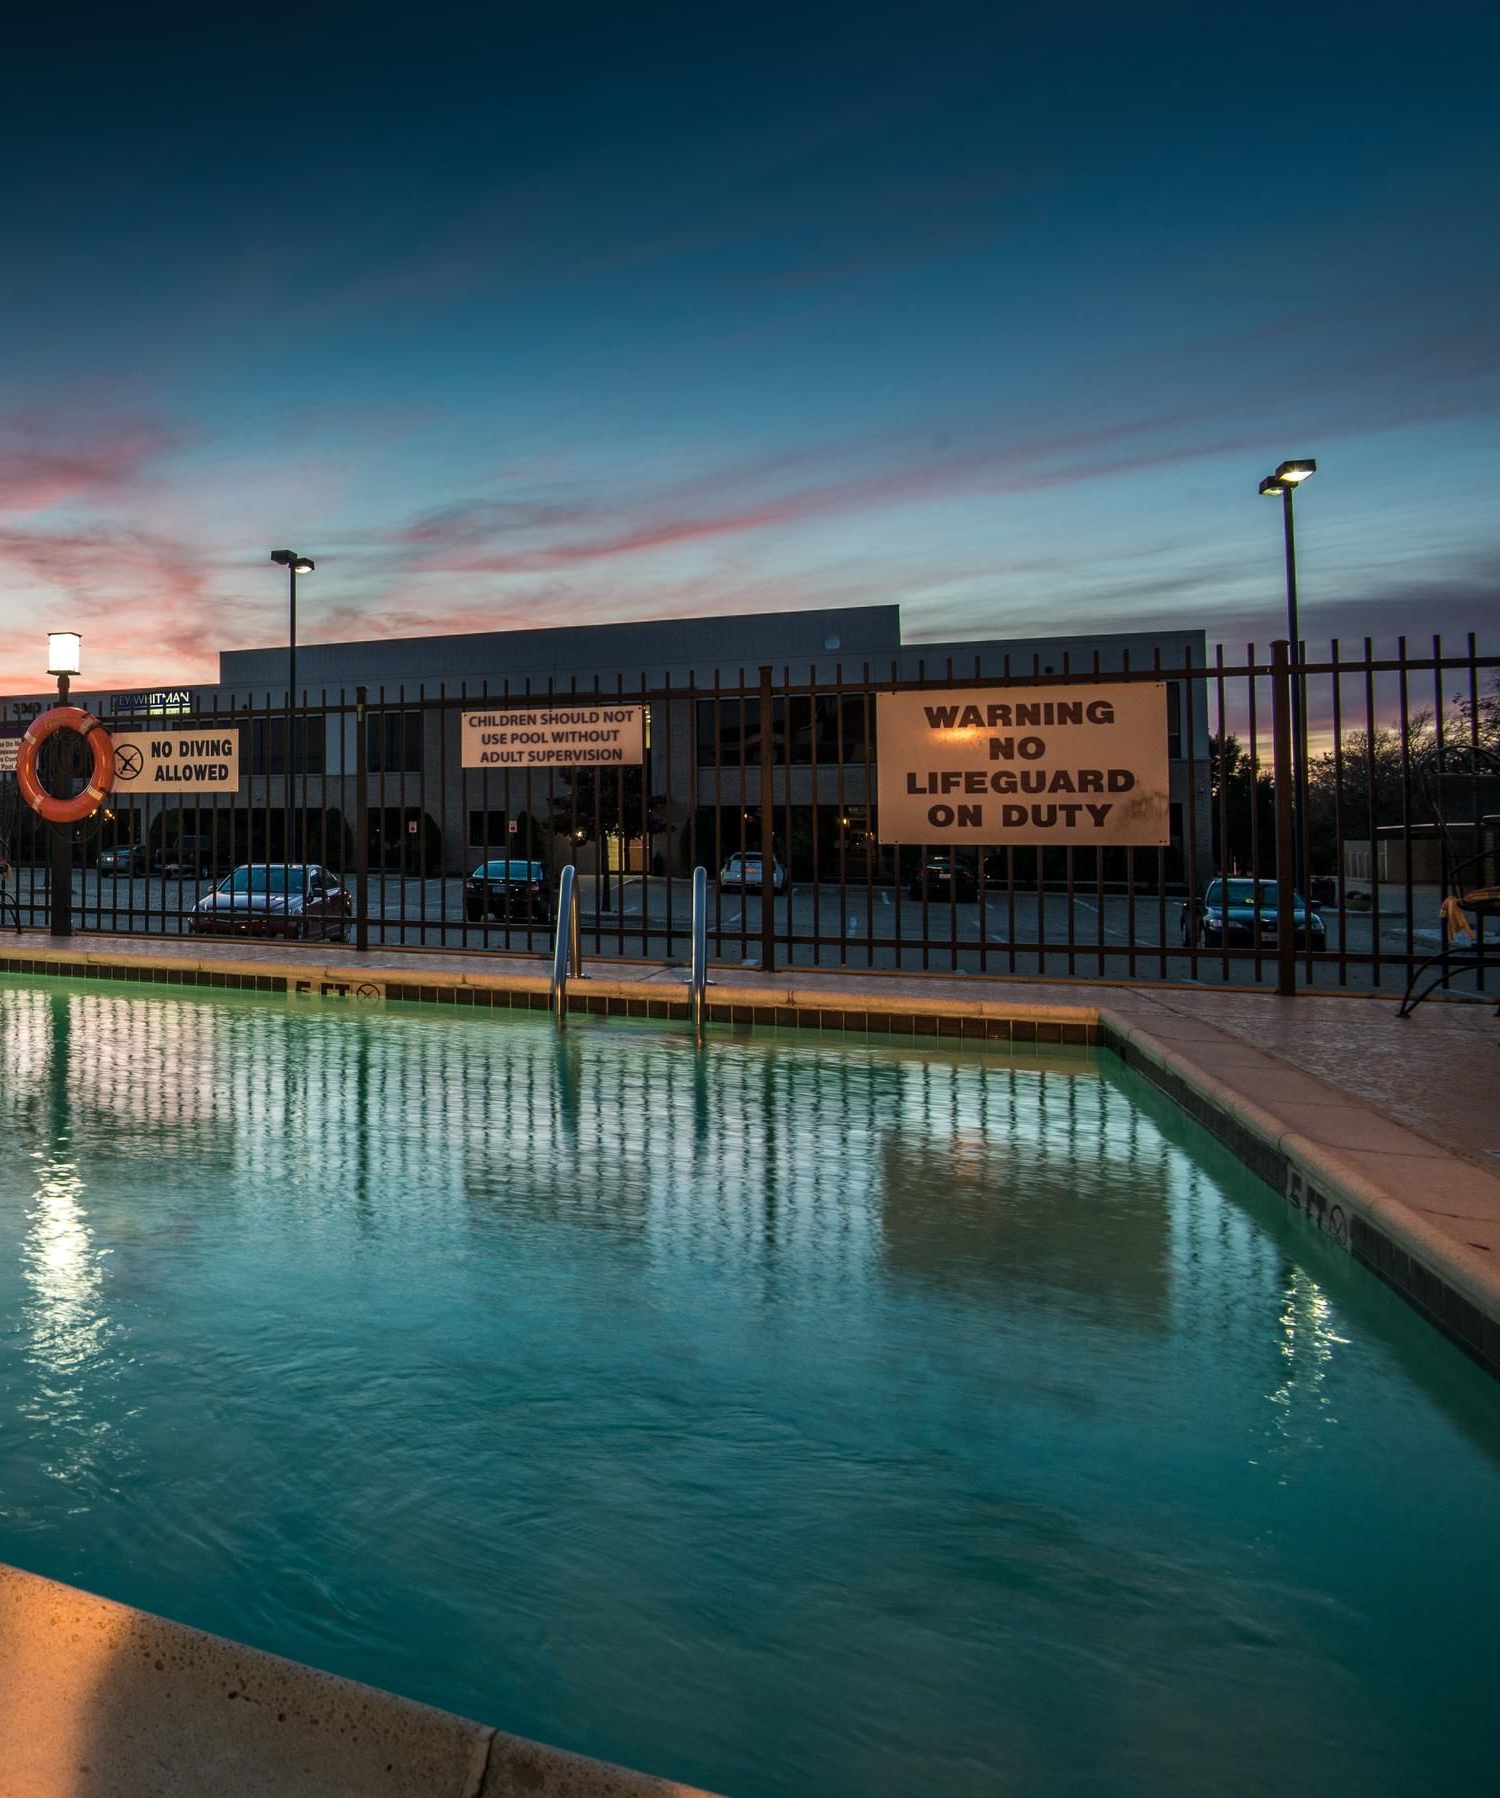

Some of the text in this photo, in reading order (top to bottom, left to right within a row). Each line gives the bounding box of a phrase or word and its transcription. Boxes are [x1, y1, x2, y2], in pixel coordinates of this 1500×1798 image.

[133, 691, 189, 705] WHITMAN
[469, 710, 634, 728] CHILDREN SHOULD NOT
[924, 700, 1115, 729] WARNING
[481, 730, 620, 745] USE POOL WITHOUT
[151, 739, 233, 758] NO DIVING
[480, 749, 623, 763] ADULT SUPERVISION
[989, 736, 1046, 761] NO
[154, 764, 229, 782] ALLOWED
[907, 769, 1135, 794] LIFEGUARD
[927, 803, 1113, 828] ON DUTY
